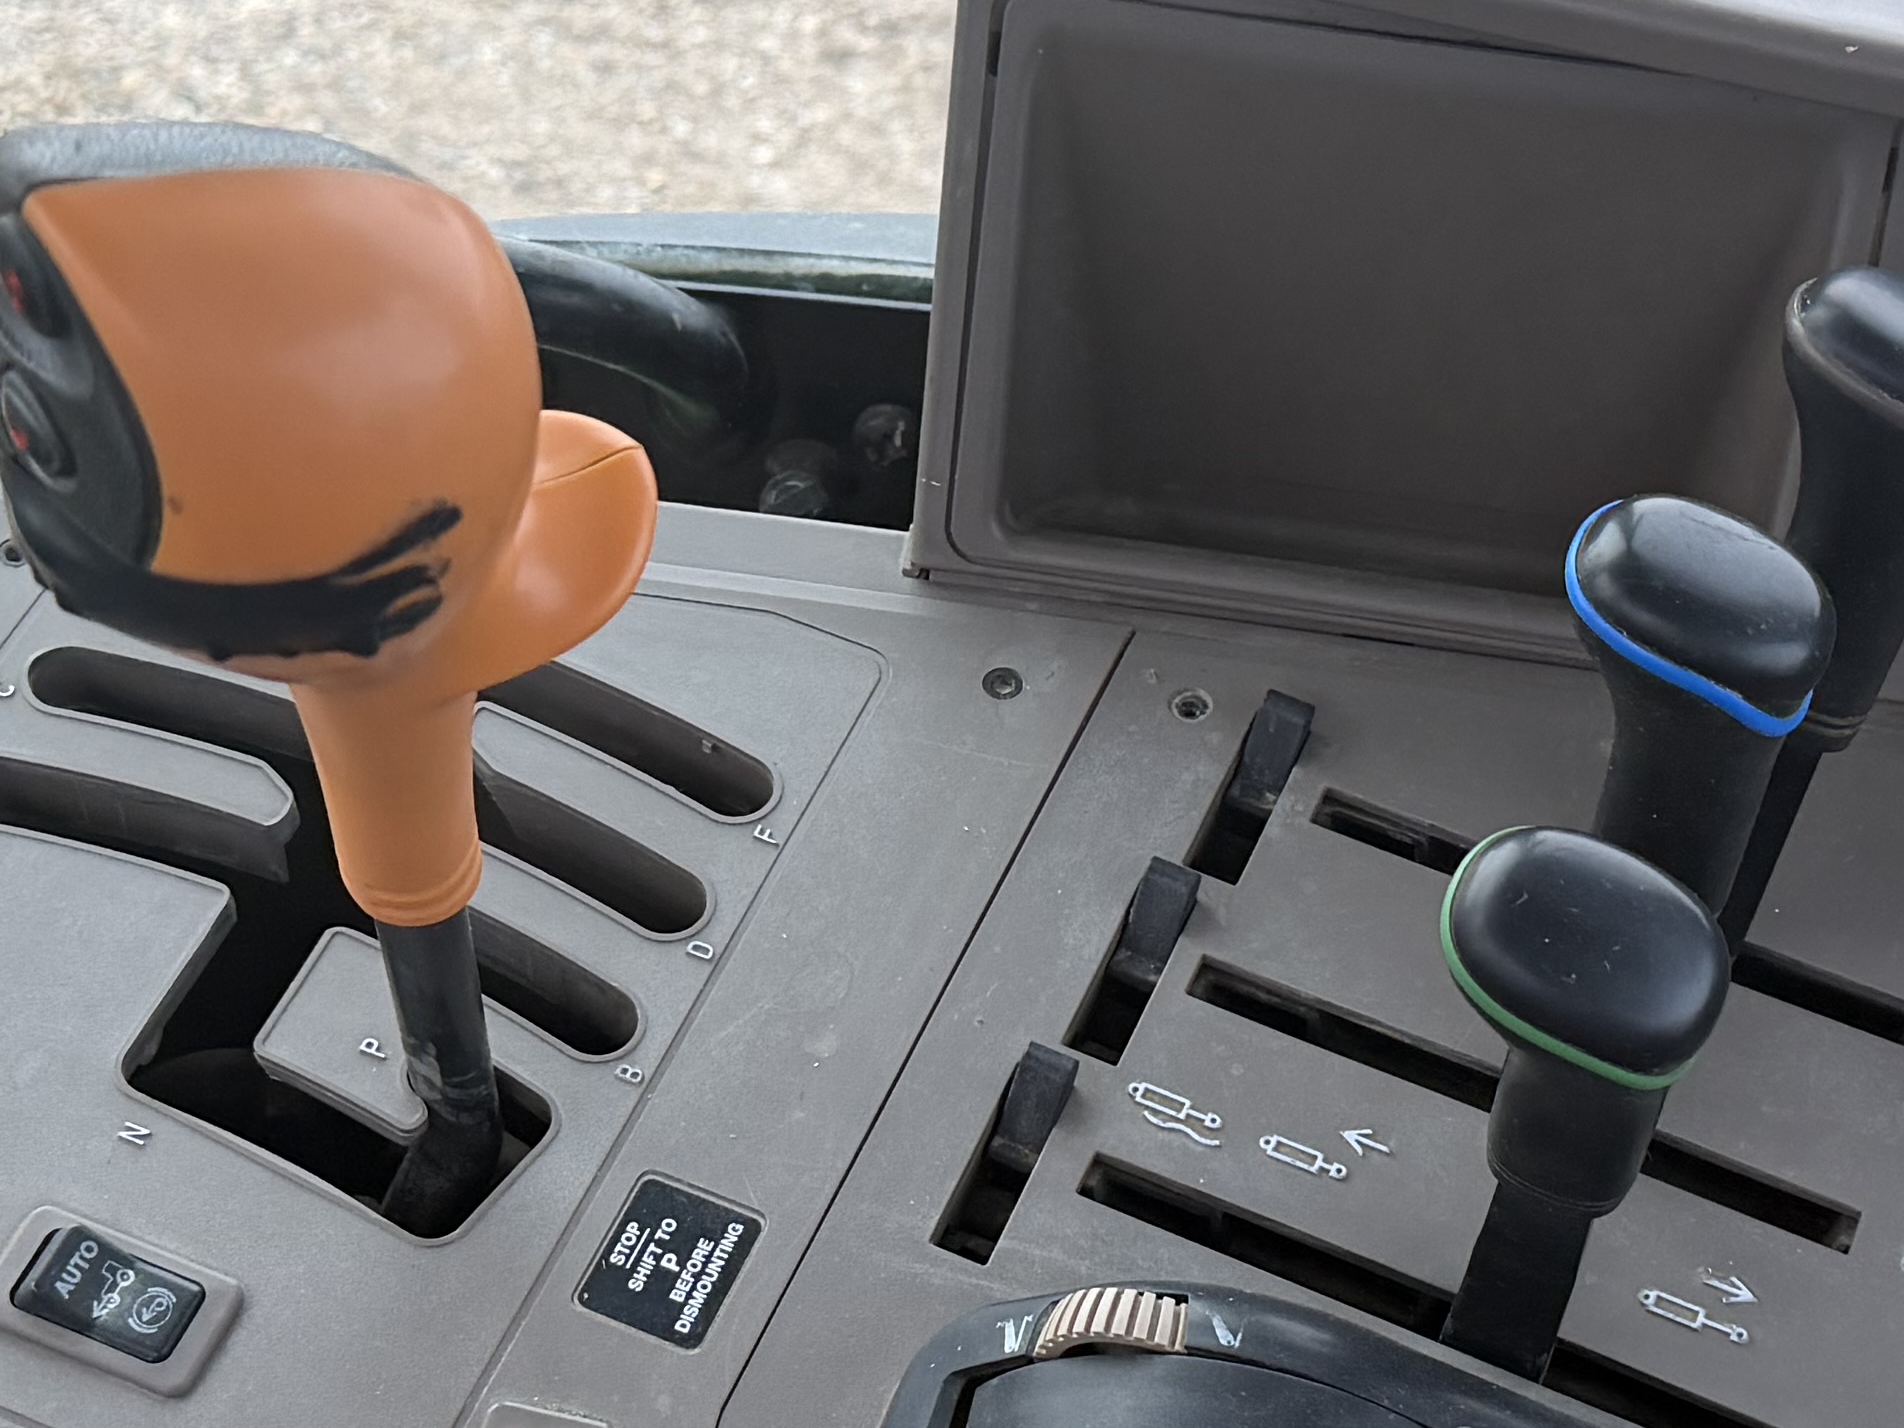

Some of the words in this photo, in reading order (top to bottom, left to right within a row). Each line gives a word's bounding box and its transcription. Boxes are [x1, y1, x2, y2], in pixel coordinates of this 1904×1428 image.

[752, 824, 779, 845] F
[686, 941, 714, 960] D
[359, 1037, 387, 1058] P
[615, 1063, 643, 1084] B
[117, 1121, 151, 1145] N
[609, 1222, 641, 1266] STOP
[628, 1243, 663, 1292] SHIFT
[654, 1218, 677, 1244] TO
[54, 1240, 99, 1299] AUTO
[661, 1252, 680, 1273] P
[669, 1237, 715, 1303] BEFORE
[674, 1222, 744, 1334] DISMOUNTING
